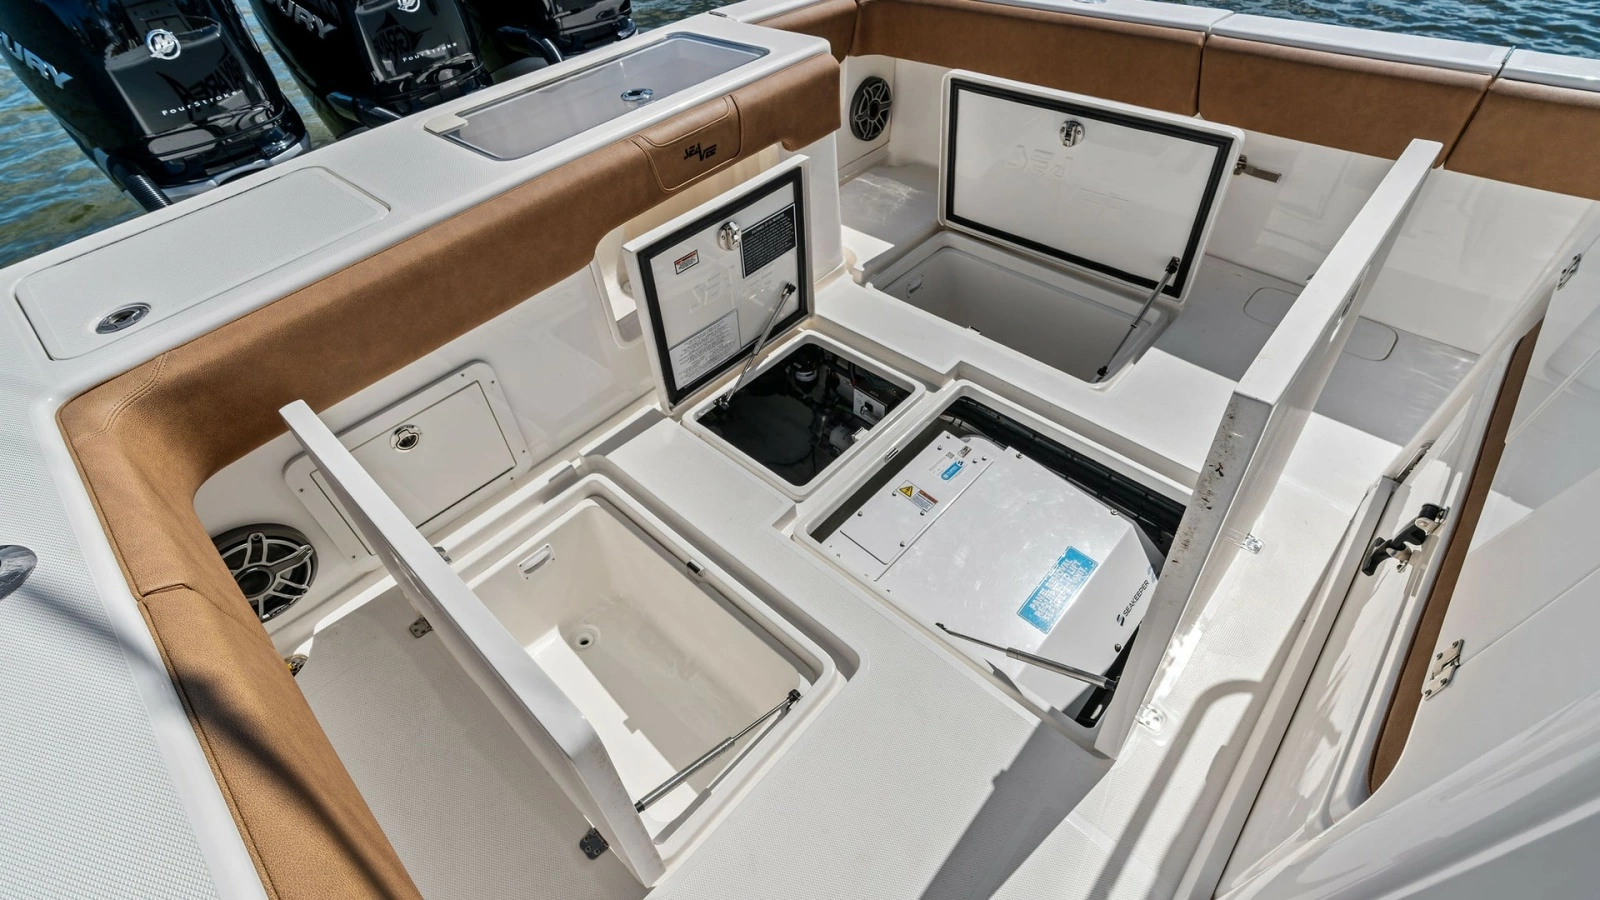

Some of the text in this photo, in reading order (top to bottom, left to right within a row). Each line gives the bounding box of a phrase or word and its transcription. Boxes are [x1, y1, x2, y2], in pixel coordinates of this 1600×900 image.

[402, 42, 458, 62] FourStroke
[161, 89, 238, 116] FourStroke
[1066, 559, 1081, 574] LIFT
[1123, 580, 1149, 617] SEAKEEPER
